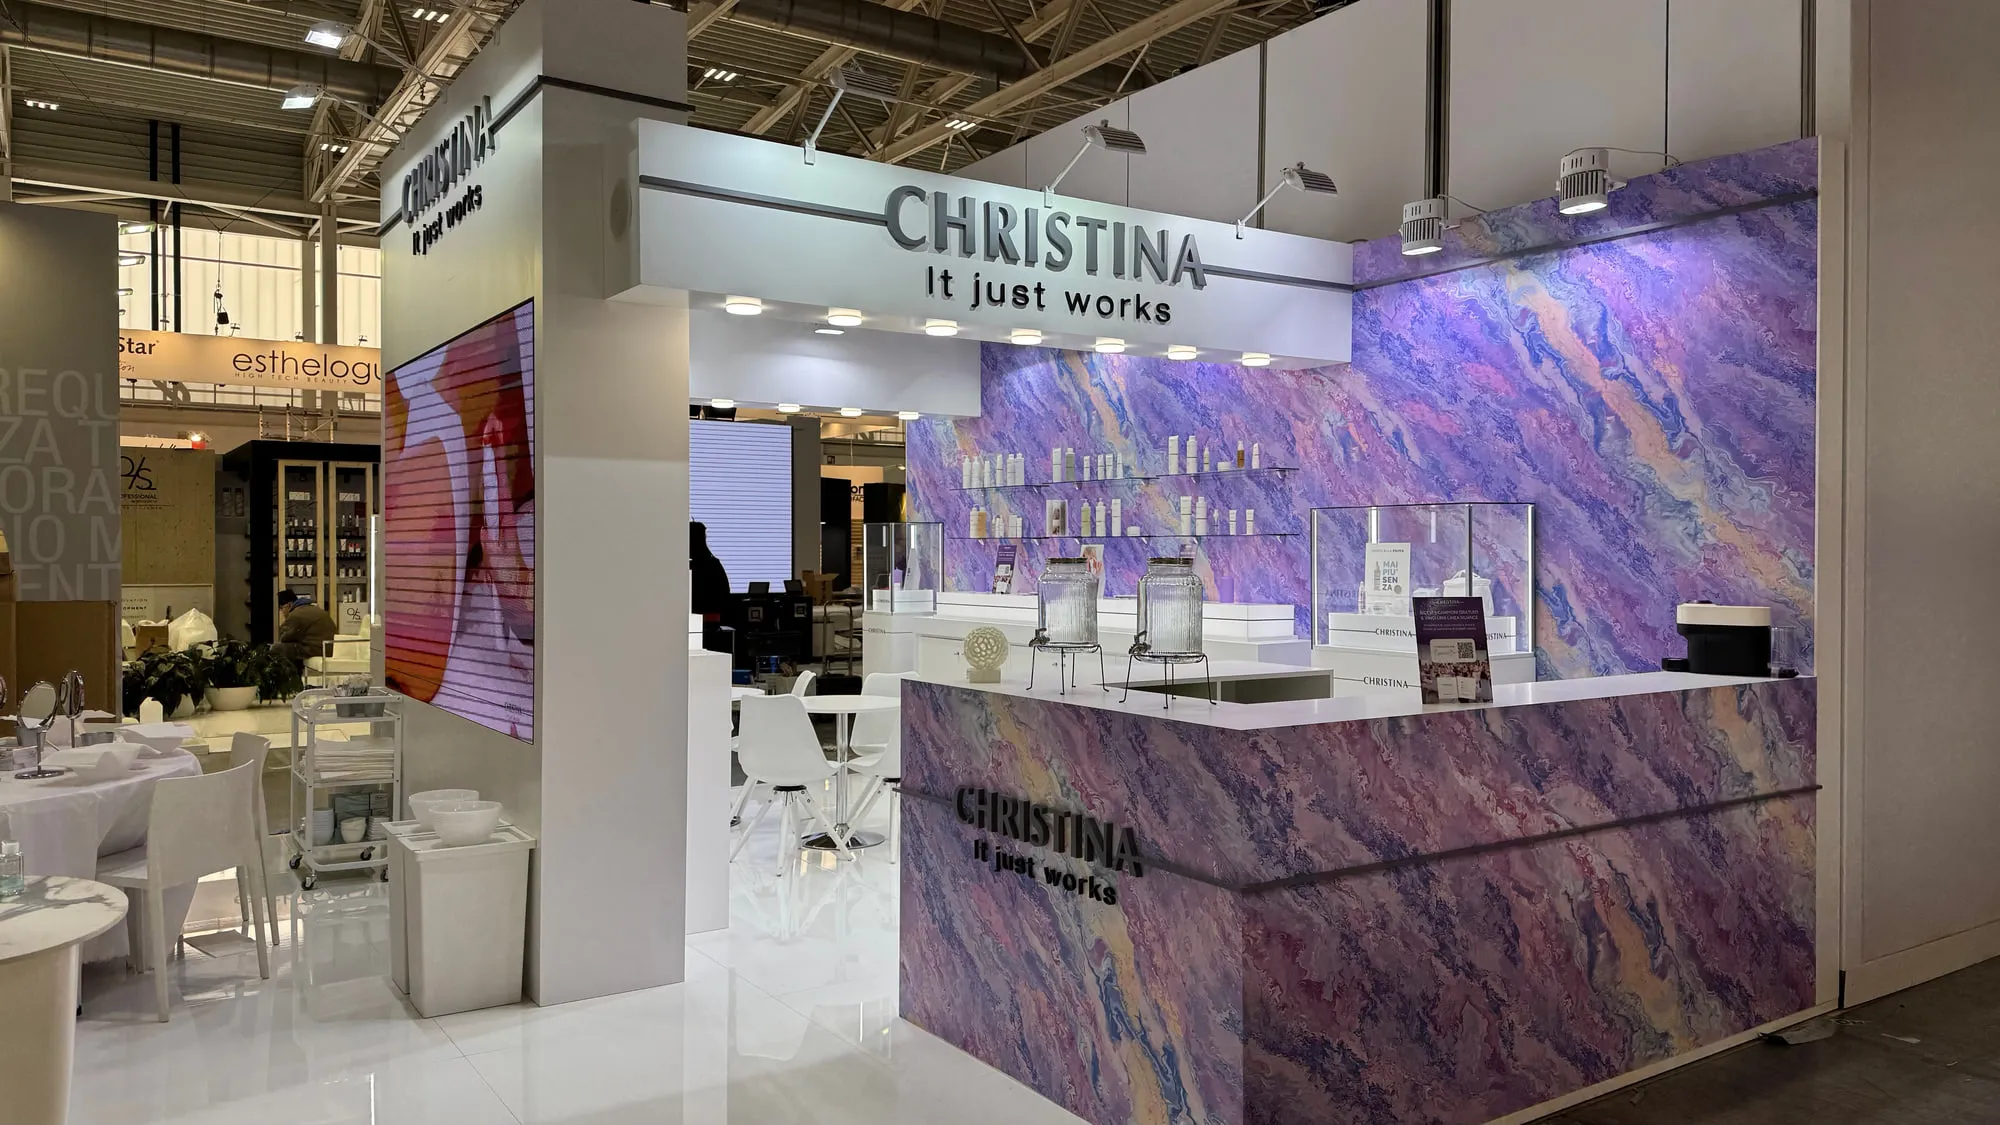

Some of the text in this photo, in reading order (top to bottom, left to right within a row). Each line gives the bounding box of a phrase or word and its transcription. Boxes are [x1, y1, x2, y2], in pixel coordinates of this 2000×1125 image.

[402, 95, 495, 224] CHRISTINA
[413, 185, 483, 256] It just works
[885, 185, 1207, 290] CHRISTINA
[927, 265, 1171, 323] It just works
[1382, 560, 1398, 568] MAI
[1382, 576, 1398, 584] SEN
[1382, 583, 1393, 591] ZA
[1375, 628, 1413, 638] CHRISTINA
[1363, 676, 1408, 688] CHRISTINA
[954, 785, 1144, 878] CHRISTINA
[974, 838, 1117, 906] It just works
